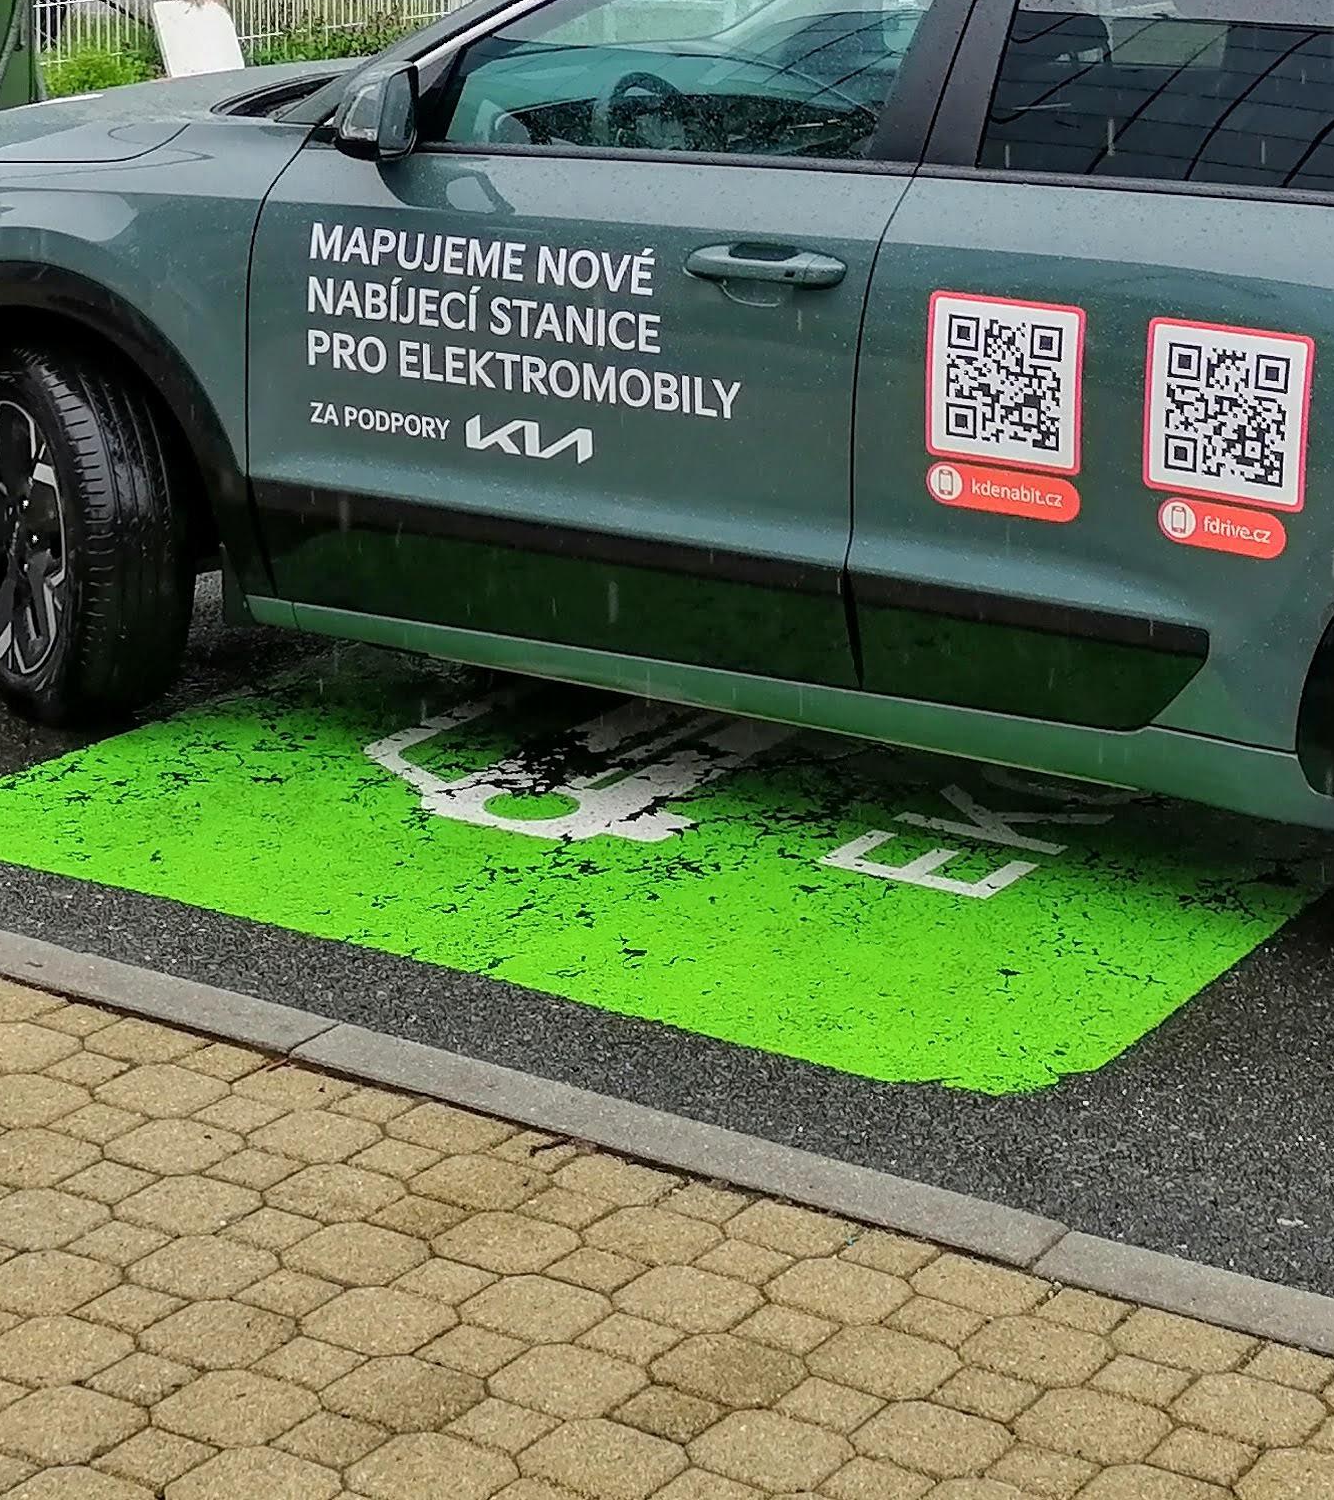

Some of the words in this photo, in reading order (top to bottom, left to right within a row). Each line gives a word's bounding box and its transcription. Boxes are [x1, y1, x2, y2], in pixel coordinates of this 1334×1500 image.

[309, 221, 527, 283] MAPUJEME
[536, 245, 656, 296] NOVÉ
[307, 276, 481, 333] NABÍJECÍ
[490, 295, 661, 354] STANICE
[307, 329, 387, 375] PRO
[399, 340, 741, 420] ELEKTROMOBILY
[309, 402, 339, 428] ZA
[344, 407, 450, 440] PODPORY
[971, 478, 1063, 508] kdenabit.cz
[1203, 514, 1271, 544] fdrive.cz
